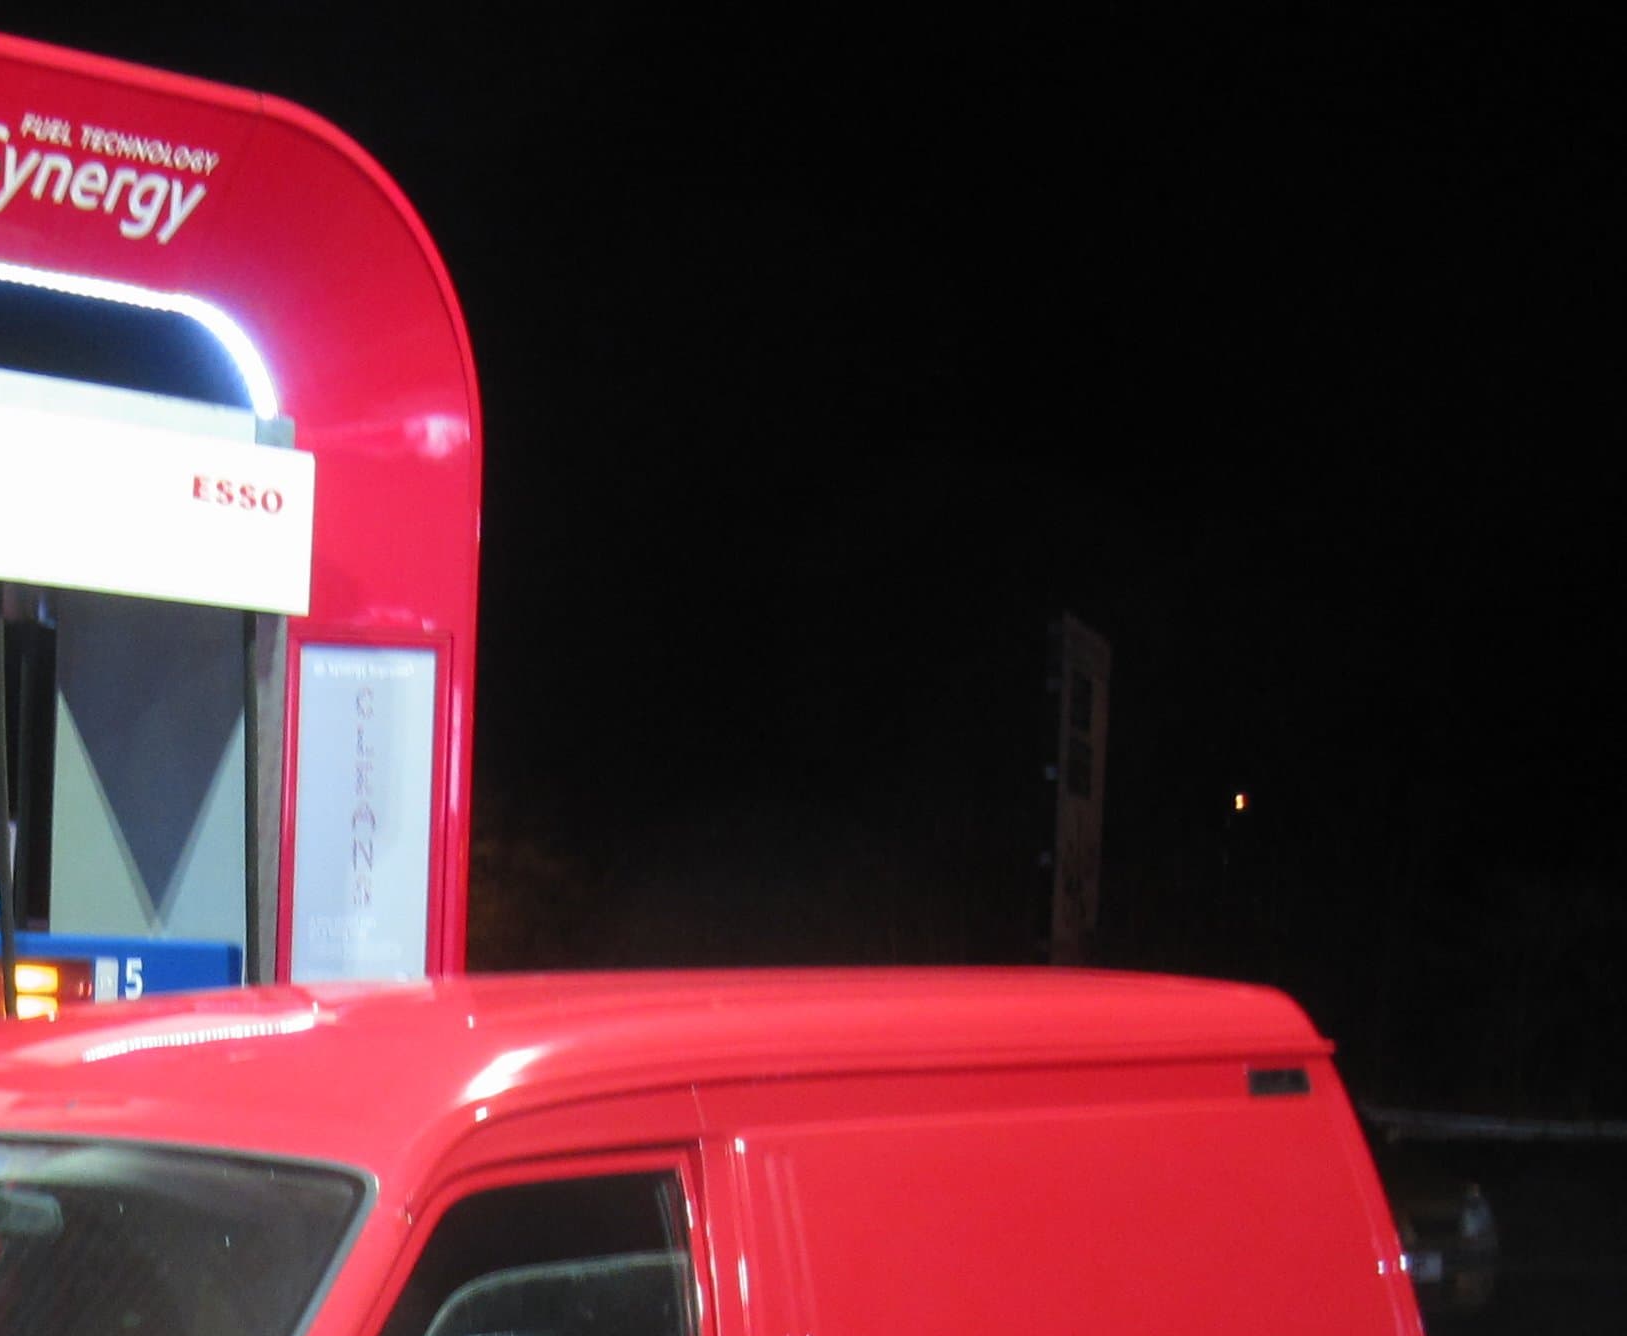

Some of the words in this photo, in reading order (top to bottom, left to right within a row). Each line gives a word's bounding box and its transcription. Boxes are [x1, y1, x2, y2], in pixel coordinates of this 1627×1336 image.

[20, 111, 73, 148] FUEL
[79, 123, 220, 177] TECHNOLOGY
[192, 475, 284, 515] ESSO
[124, 956, 144, 1001] 5
